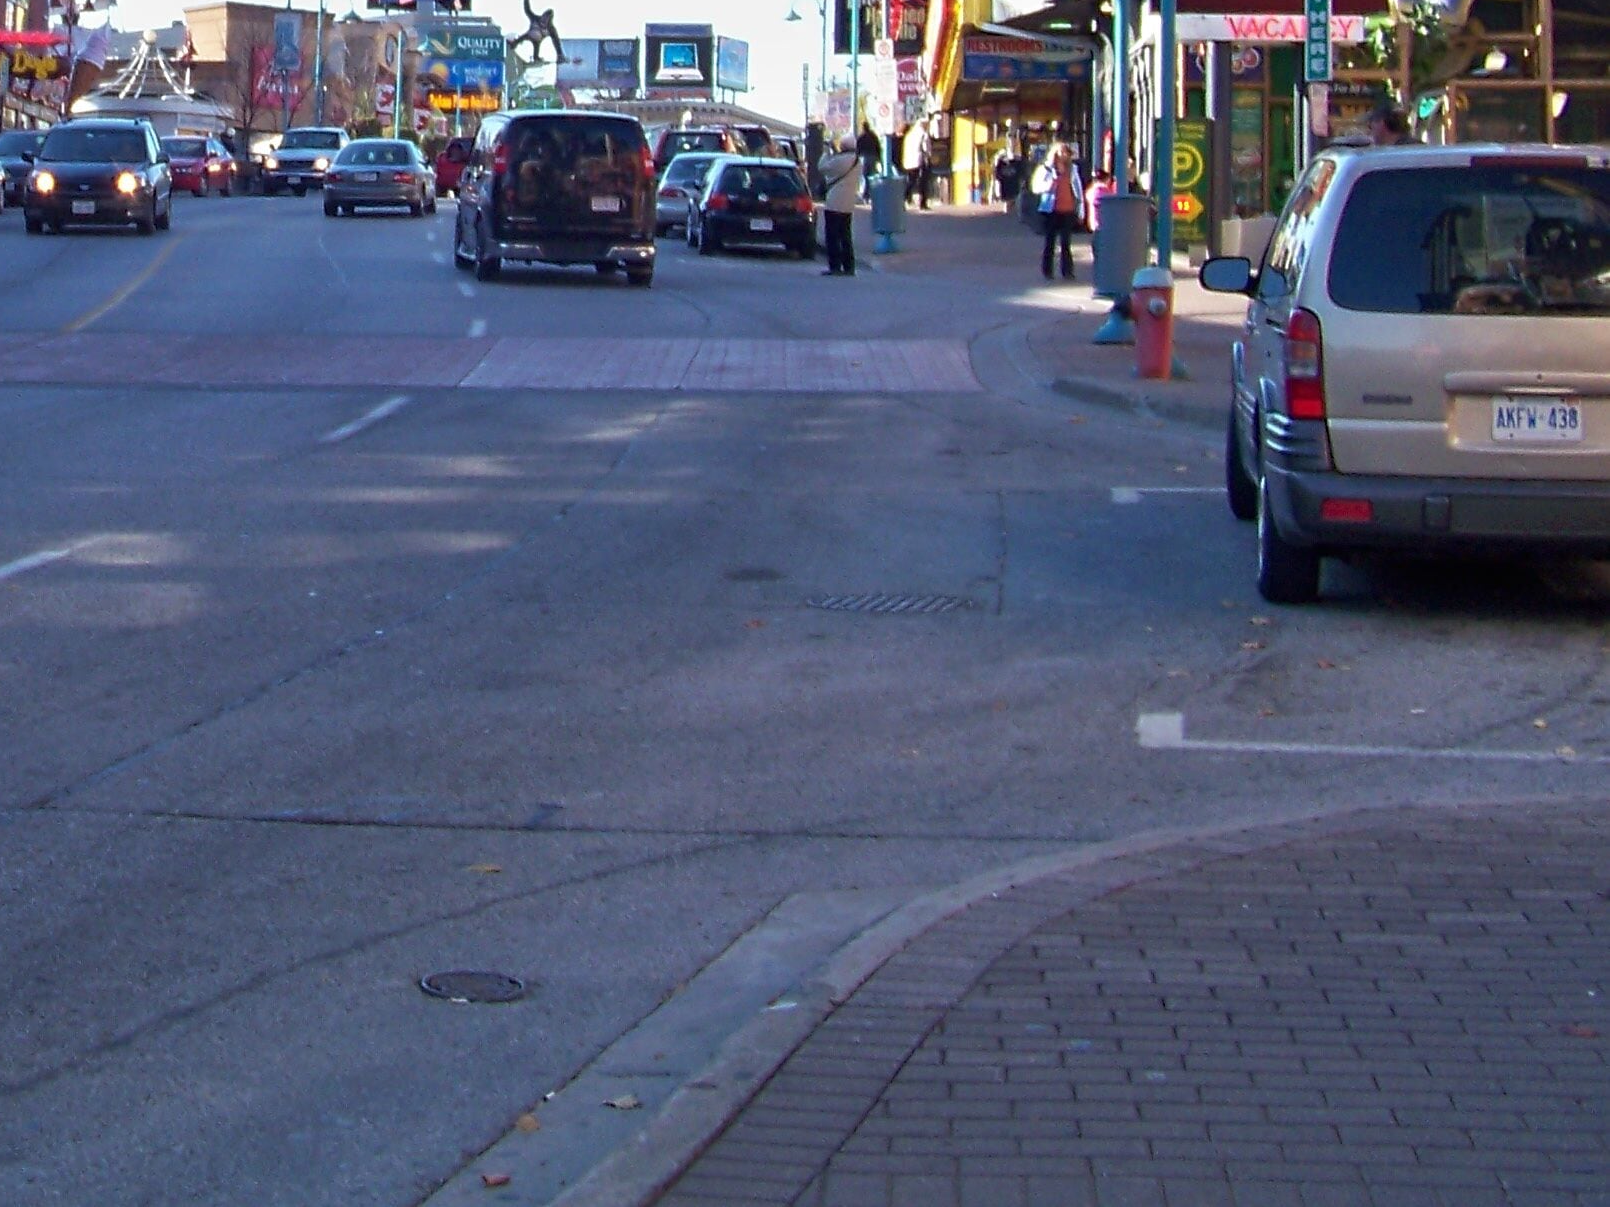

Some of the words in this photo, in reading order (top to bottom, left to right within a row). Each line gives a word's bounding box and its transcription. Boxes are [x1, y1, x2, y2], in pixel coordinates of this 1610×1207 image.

[1224, 16, 1354, 38] VACAY
[457, 36, 502, 49] QUALITY
[1309, 10, 1326, 73] HERE
